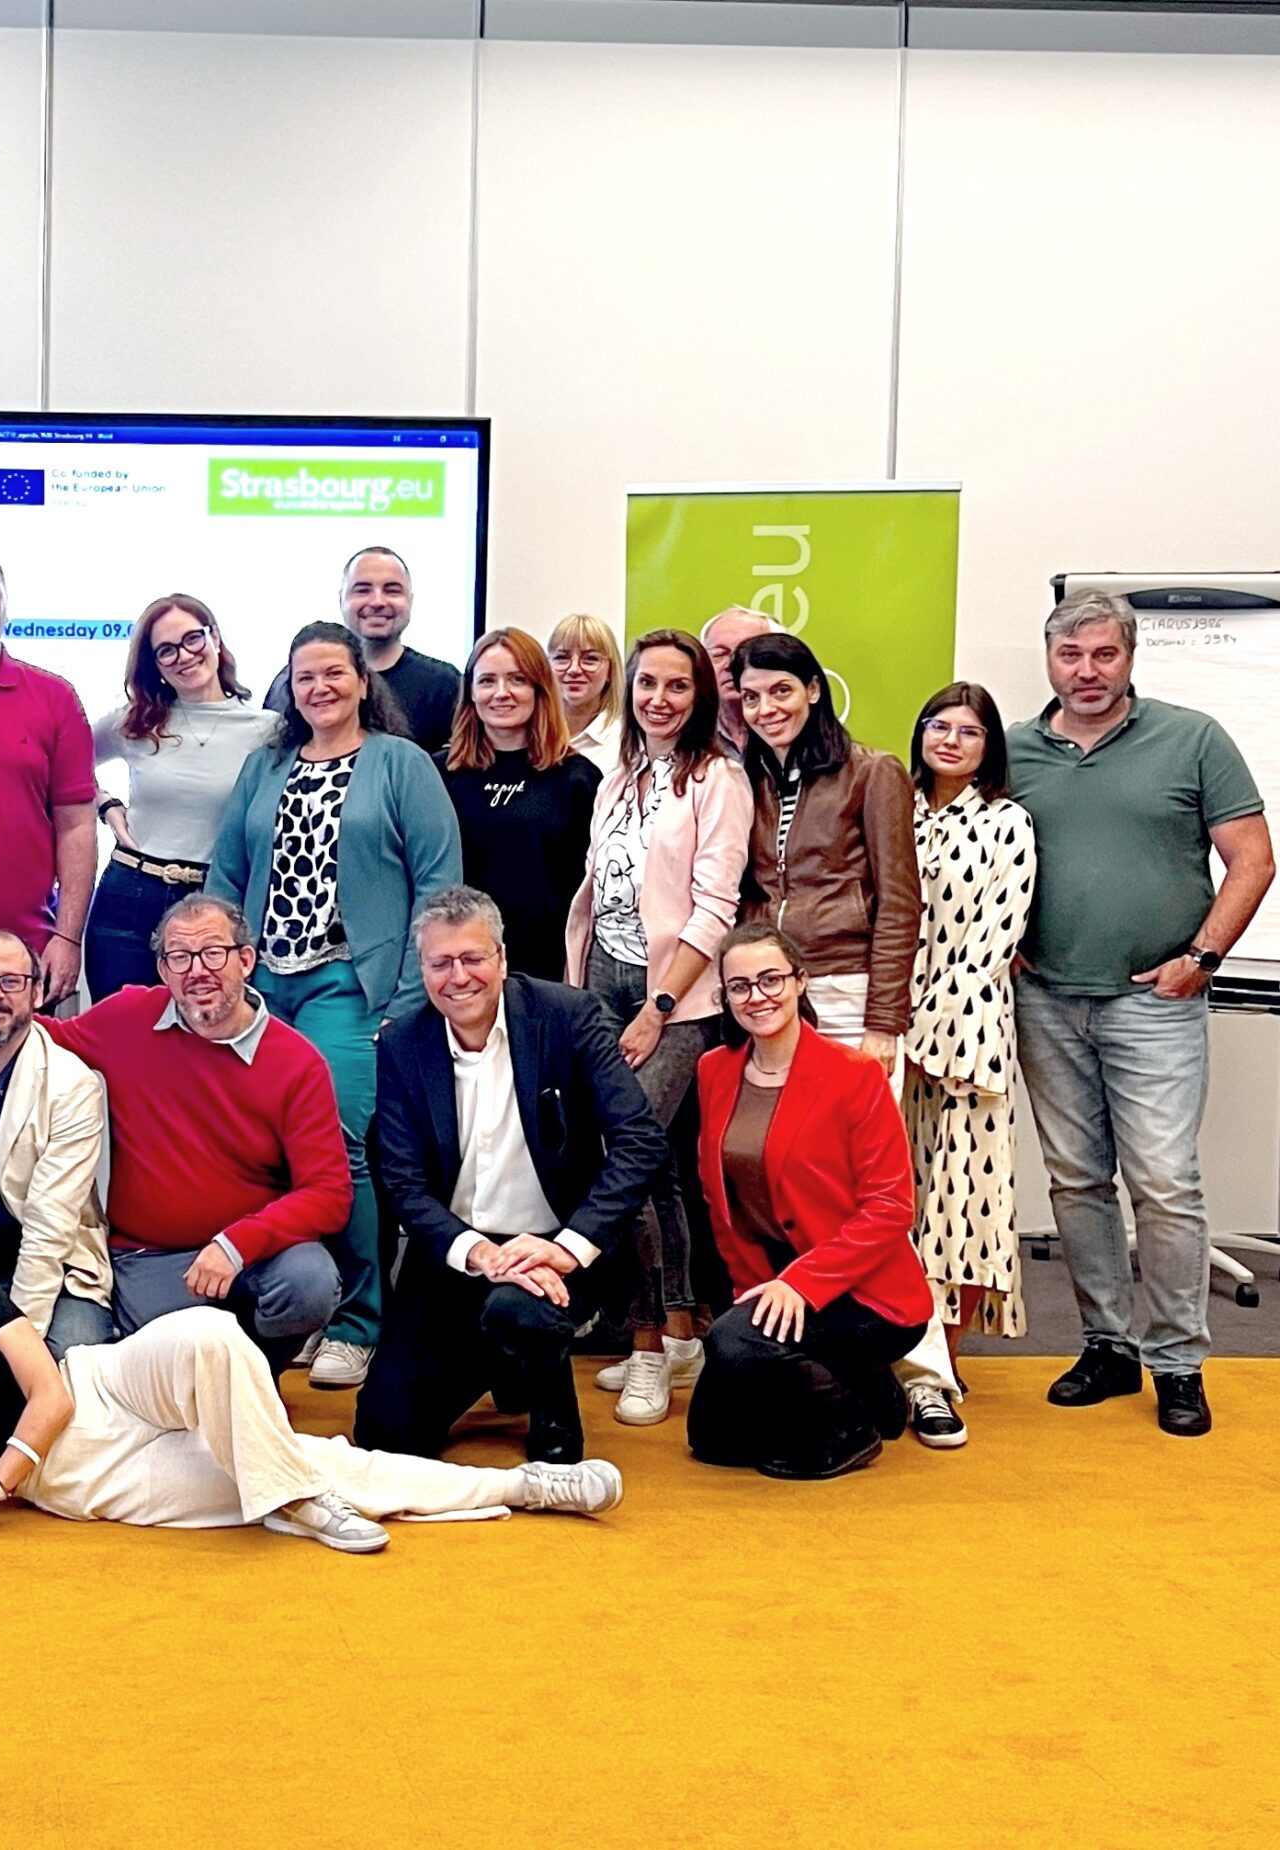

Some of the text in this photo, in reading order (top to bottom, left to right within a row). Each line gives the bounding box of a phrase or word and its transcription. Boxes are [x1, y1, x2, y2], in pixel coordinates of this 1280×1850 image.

[115, 470, 129, 480] by
[73, 483, 128, 493] European
[132, 484, 166, 494] Union
[221, 467, 433, 512] Strasbourg.eu
